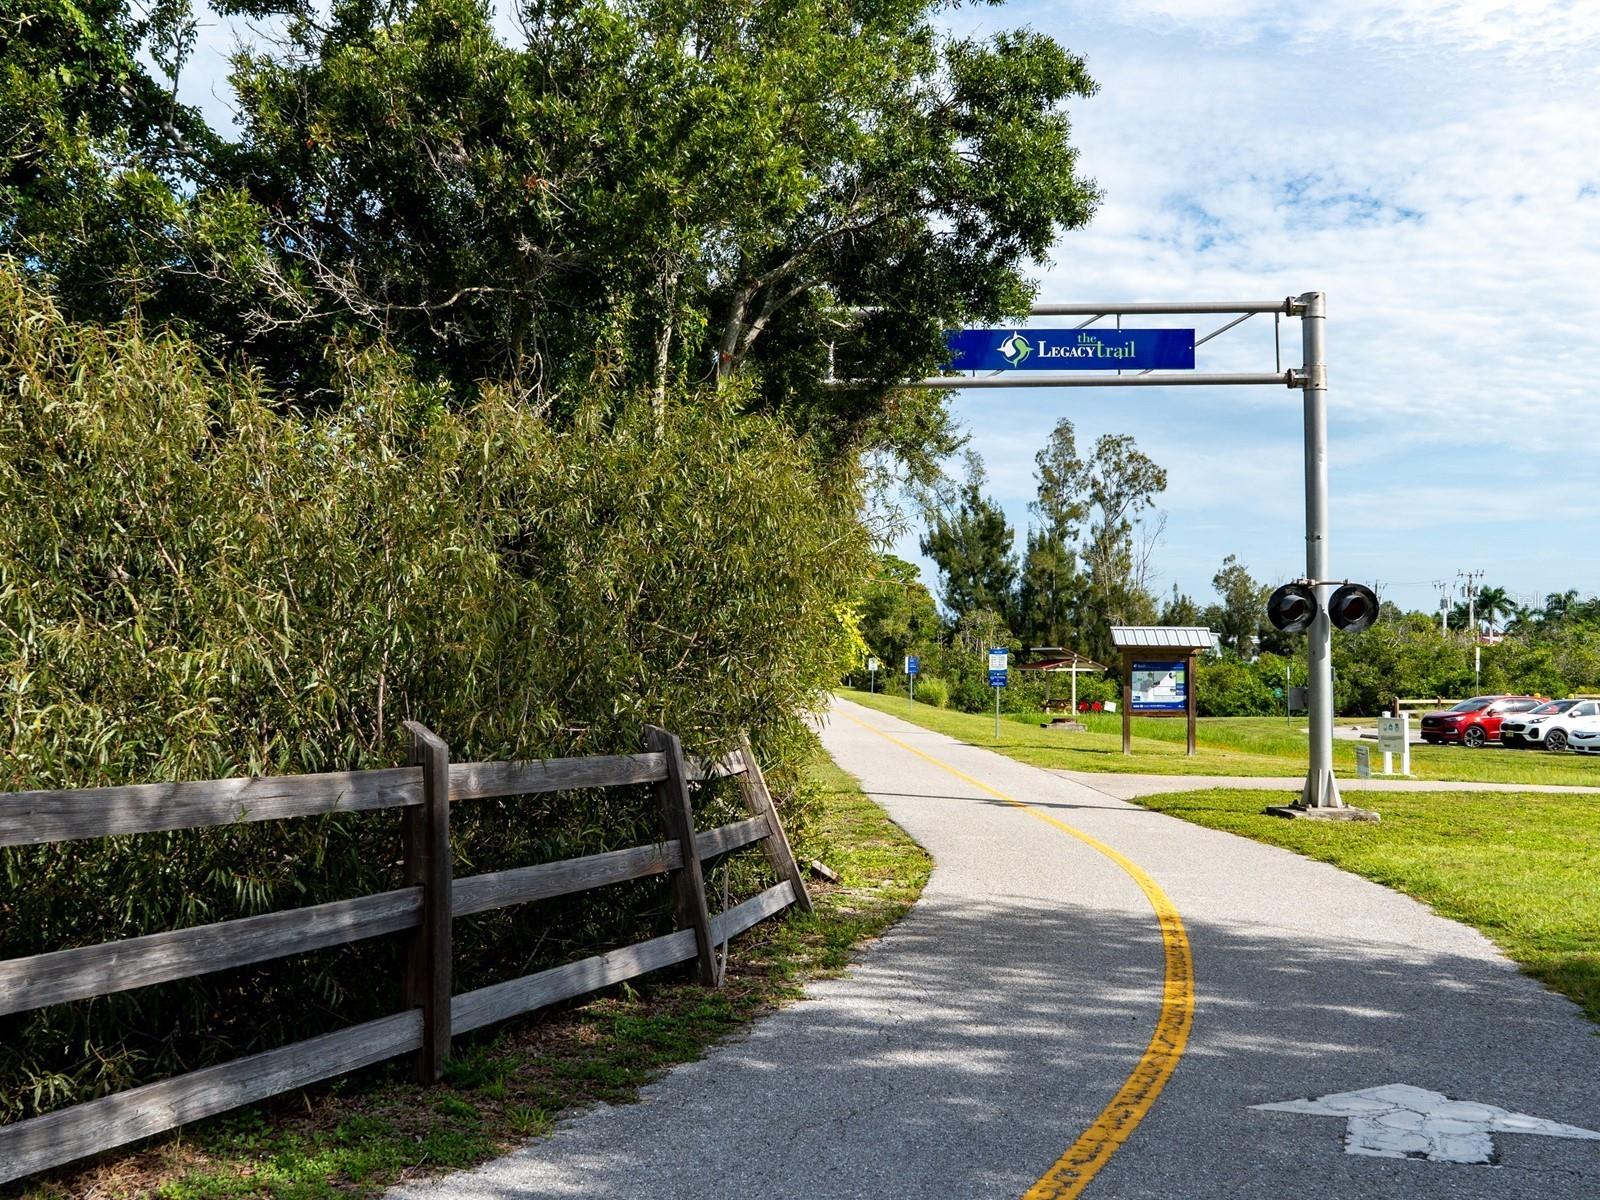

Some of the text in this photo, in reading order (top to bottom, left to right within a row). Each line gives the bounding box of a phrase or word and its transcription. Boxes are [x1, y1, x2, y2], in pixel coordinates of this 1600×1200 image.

[1077, 332, 1097, 343] the
[1037, 340, 1136, 358] LEGACY trail
